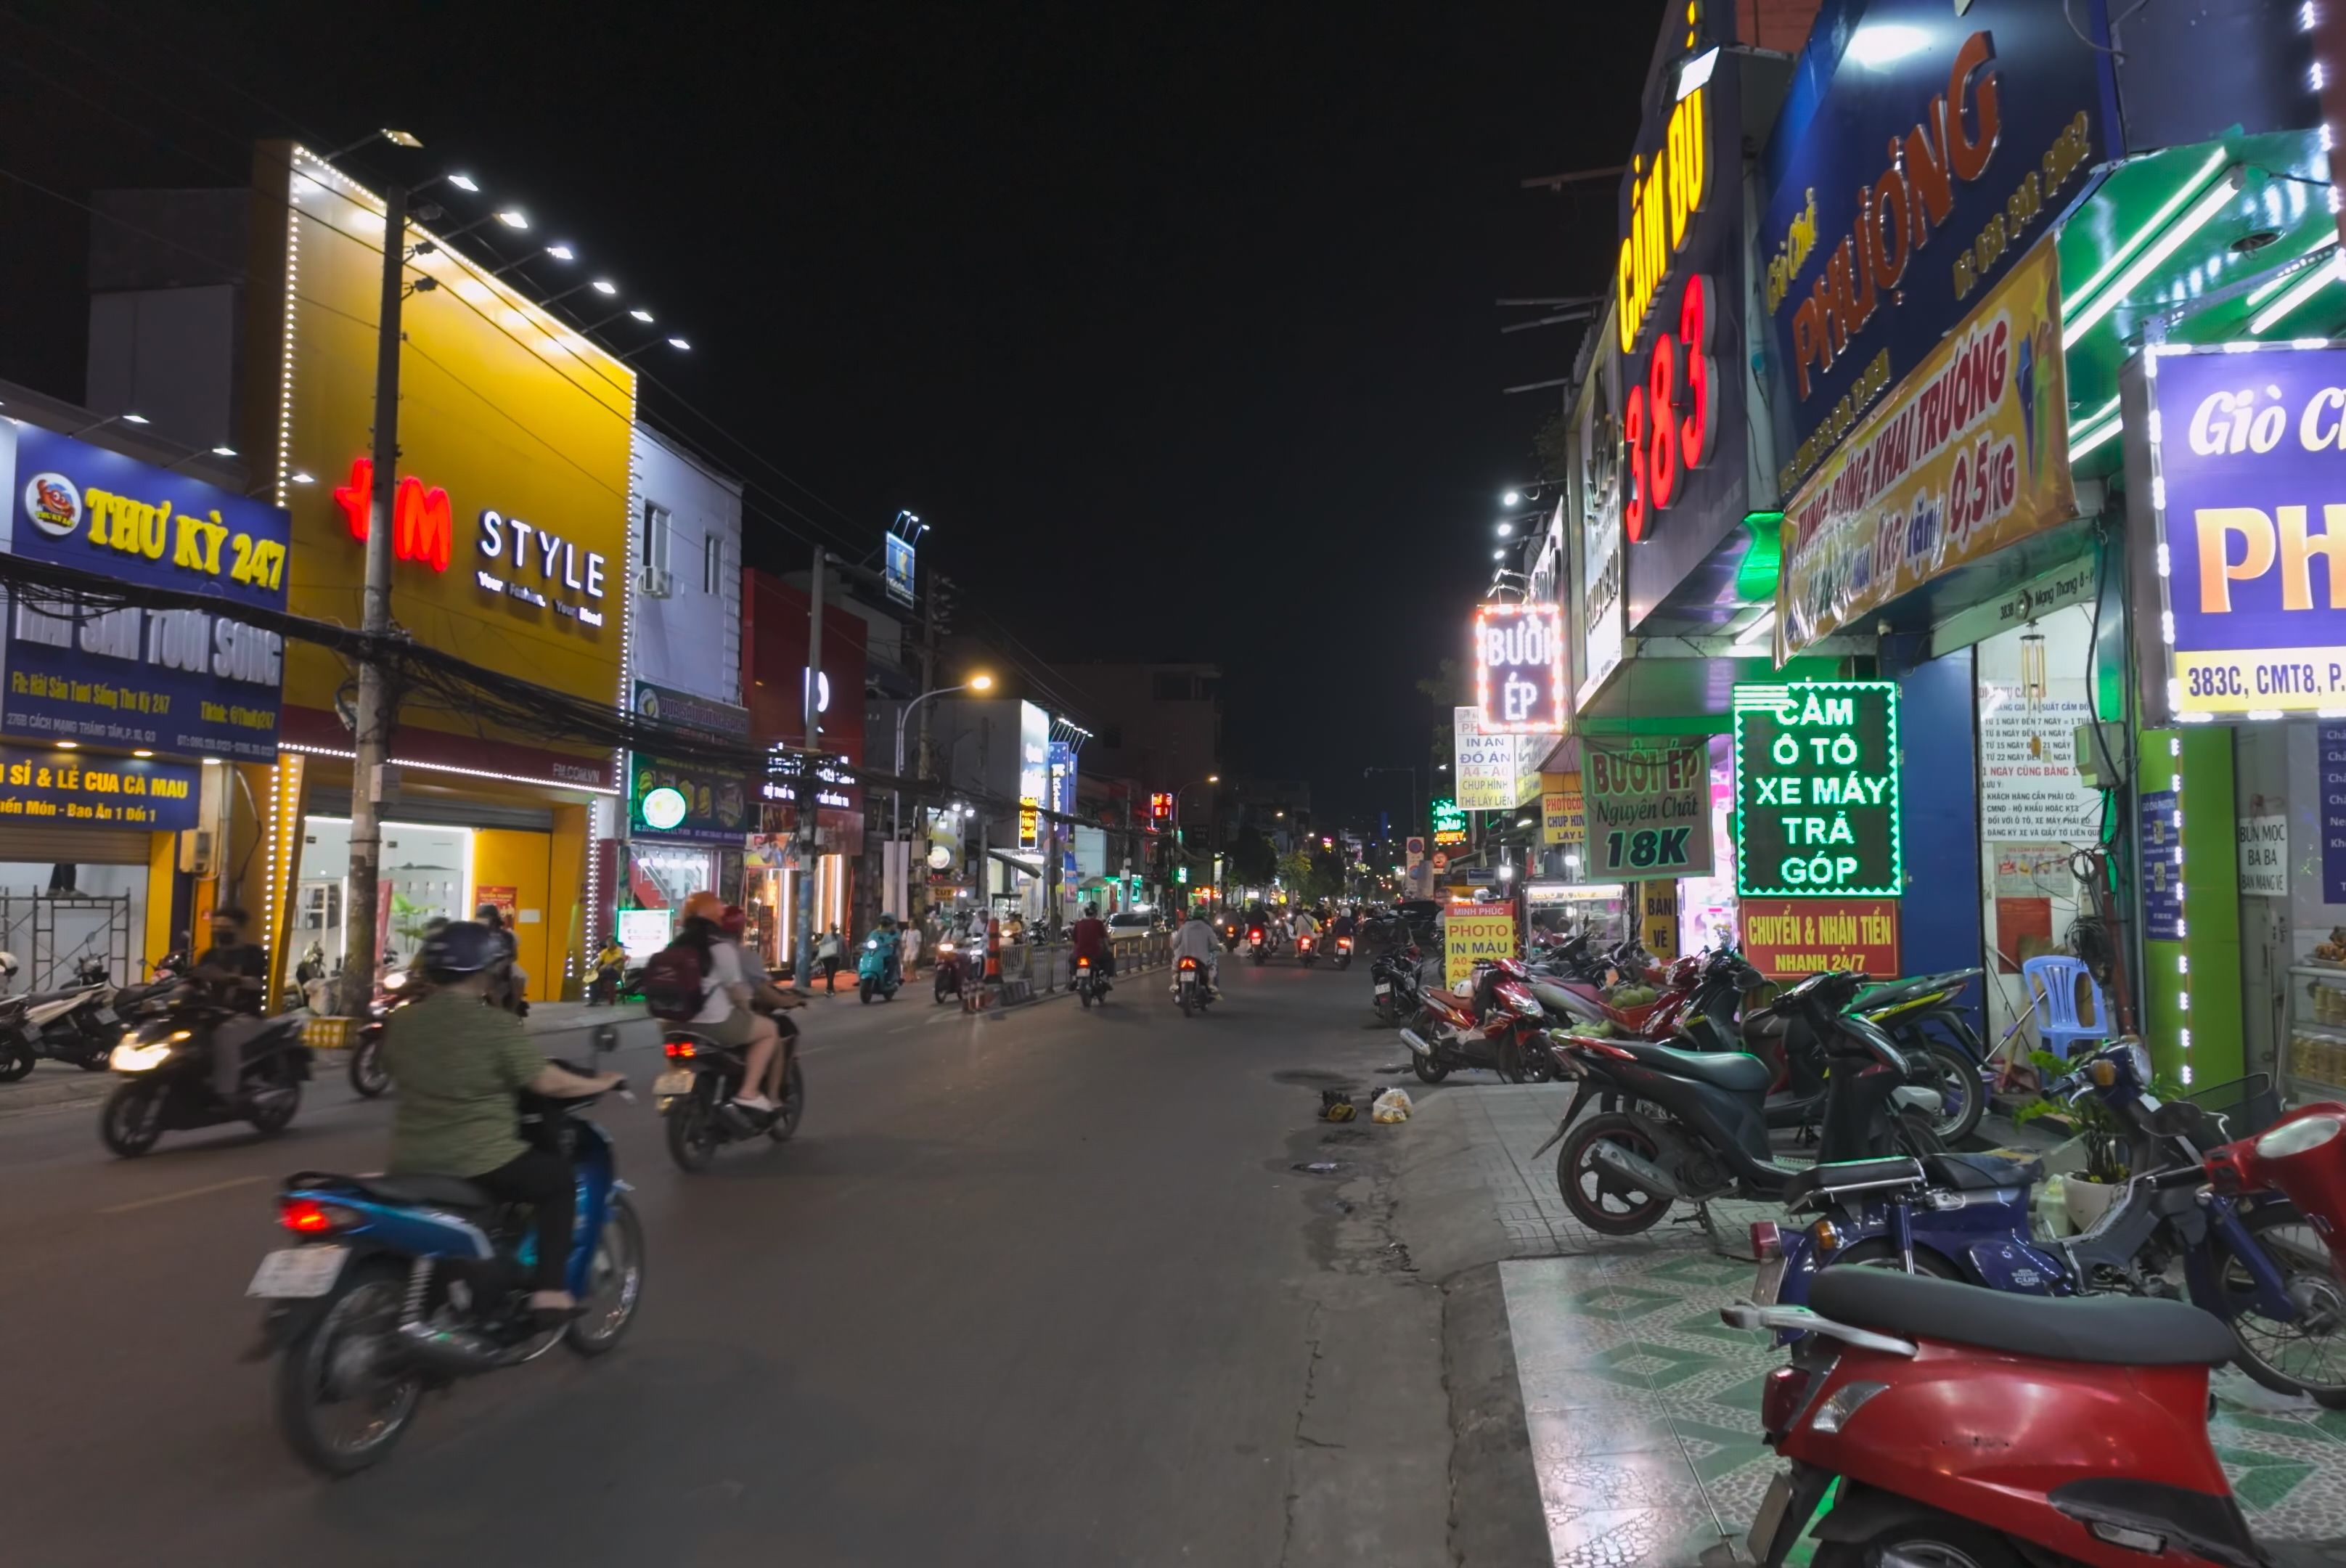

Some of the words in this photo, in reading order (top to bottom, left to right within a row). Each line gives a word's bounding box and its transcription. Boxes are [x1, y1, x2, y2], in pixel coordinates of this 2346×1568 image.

[1792, 30, 2003, 402] PHƯỢNG
[1627, 274, 1706, 544] 383
[2188, 384, 2287, 456] Giò
[1870, 403, 1915, 499] KHAI
[85, 487, 171, 559] THƯ
[173, 510, 228, 575] KỲ
[230, 534, 286, 591] 247
[479, 510, 604, 597] STYLE
[1504, 671, 1537, 720] ÉP
[2188, 666, 2249, 699] 383C,
[2255, 663, 2322, 697] CMT8,
[152, 694, 171, 714] 247
[2002, 716, 2019, 725] NGÀY
[2043, 716, 2061, 725] NGÀY
[29, 713, 52, 730] CÁCH
[1466, 738, 1481, 747] IN
[1773, 732, 1799, 765] Ô
[1810, 732, 1858, 765] TÔ
[2007, 752, 2025, 761] NGÀY
[2053, 752, 2071, 761] NGÀY
[9, 759, 31, 785] SỈ
[37, 767, 52, 788] &
[57, 764, 80, 790] LẺ
[85, 772, 120, 793] CUA
[123, 772, 146, 796] CÀ
[150, 777, 189, 799] MAU
[1463, 767, 1481, 777] A4
[1592, 738, 1660, 796] BƯỞI
[1666, 738, 1699, 792] ÉP
[1990, 764, 2014, 776] NGÀY
[2016, 764, 2041, 776] CŨNG
[2072, 767, 2077, 776] 1
[1755, 777, 1802, 805] XE
[1812, 770, 1888, 805] MÁY
[1987, 791, 2010, 799] KHÁCH
[26, 800, 56, 816] Món
[67, 803, 93, 818] Bao
[116, 807, 122, 820] 1
[150, 809, 155, 822] 1
[1597, 798, 1657, 826] Nguyên
[1662, 792, 1698, 819] Chất
[2012, 804, 2022, 813] HỘ
[2015, 815, 2019, 824] Ô
[2046, 815, 2061, 824] MÁY
[1781, 811, 1855, 845] TRẢ
[1606, 825, 1693, 870] 18K
[1781, 850, 1858, 884] GÓP
[1479, 905, 1505, 915] PHÚC
[1449, 924, 1508, 937] PHOTO
[1748, 904, 1802, 947] CHUYỂN
[1805, 916, 1815, 946] &
[1818, 909, 1857, 952] NHẬN
[1451, 942, 1466, 954] IN
[1472, 939, 1508, 954] MÀU
[1775, 954, 1828, 972] NHANH
[1831, 954, 1865, 973] 24/7
